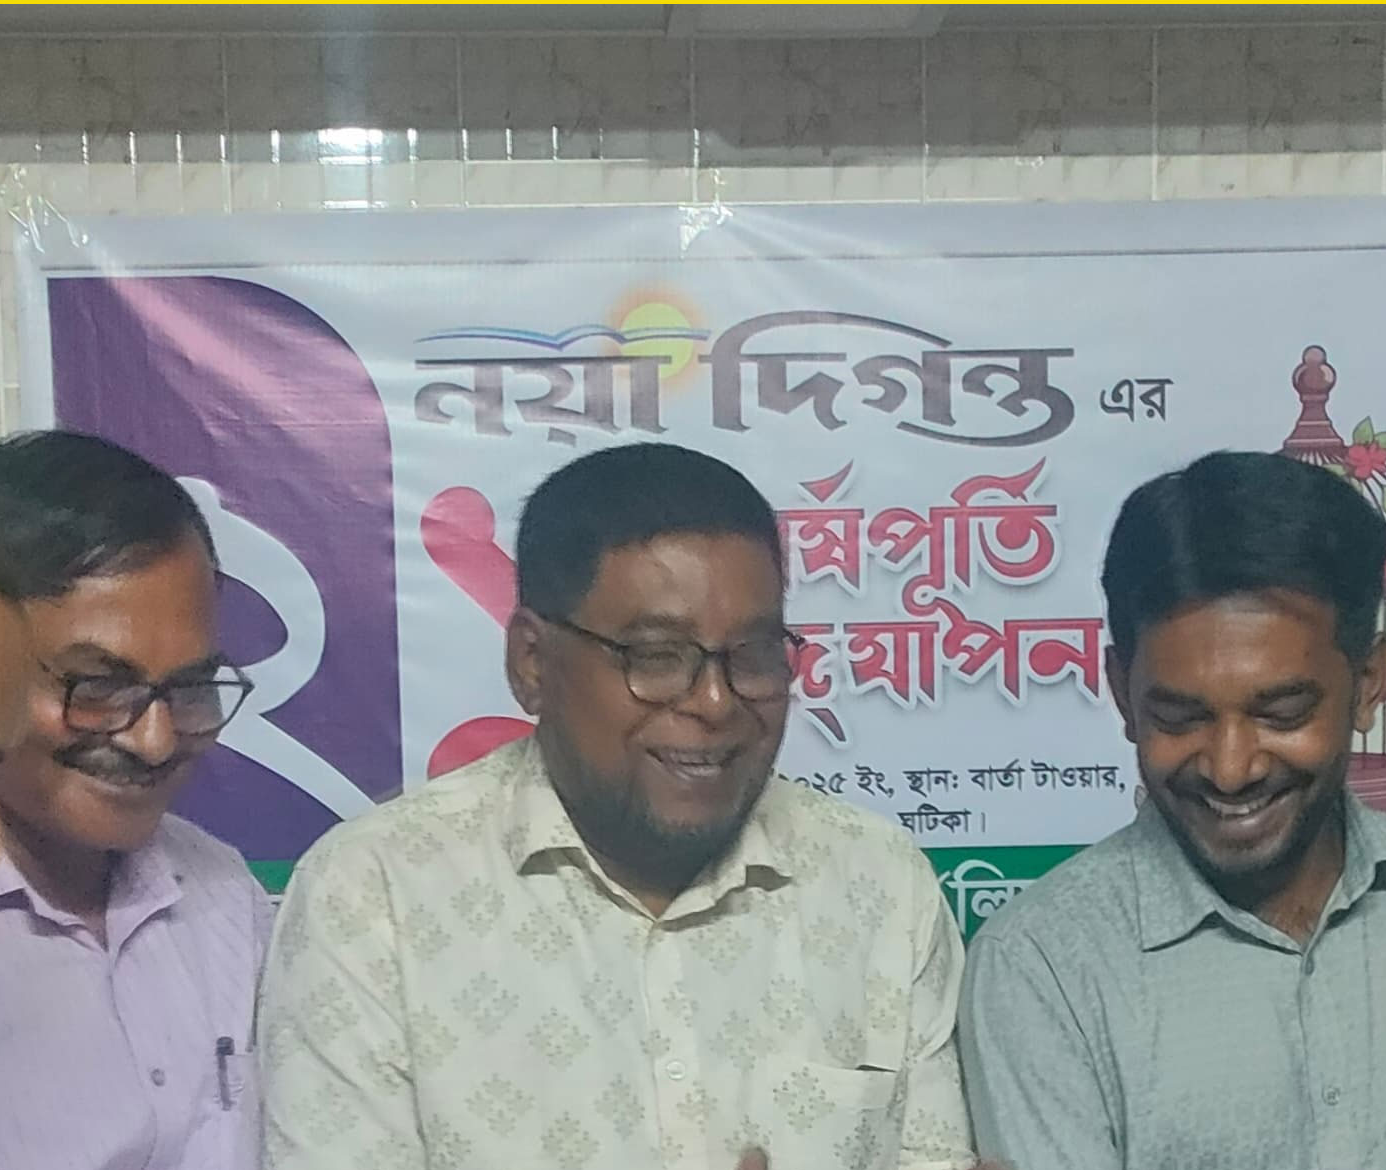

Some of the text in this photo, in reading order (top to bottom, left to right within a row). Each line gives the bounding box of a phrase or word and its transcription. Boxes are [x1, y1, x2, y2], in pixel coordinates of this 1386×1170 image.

[415, 310, 1173, 447] নয়া দিগন্ত এর
[776, 456, 1057, 618] র্ষপূর্তি
[968, 759, 1025, 791] বার্তা
